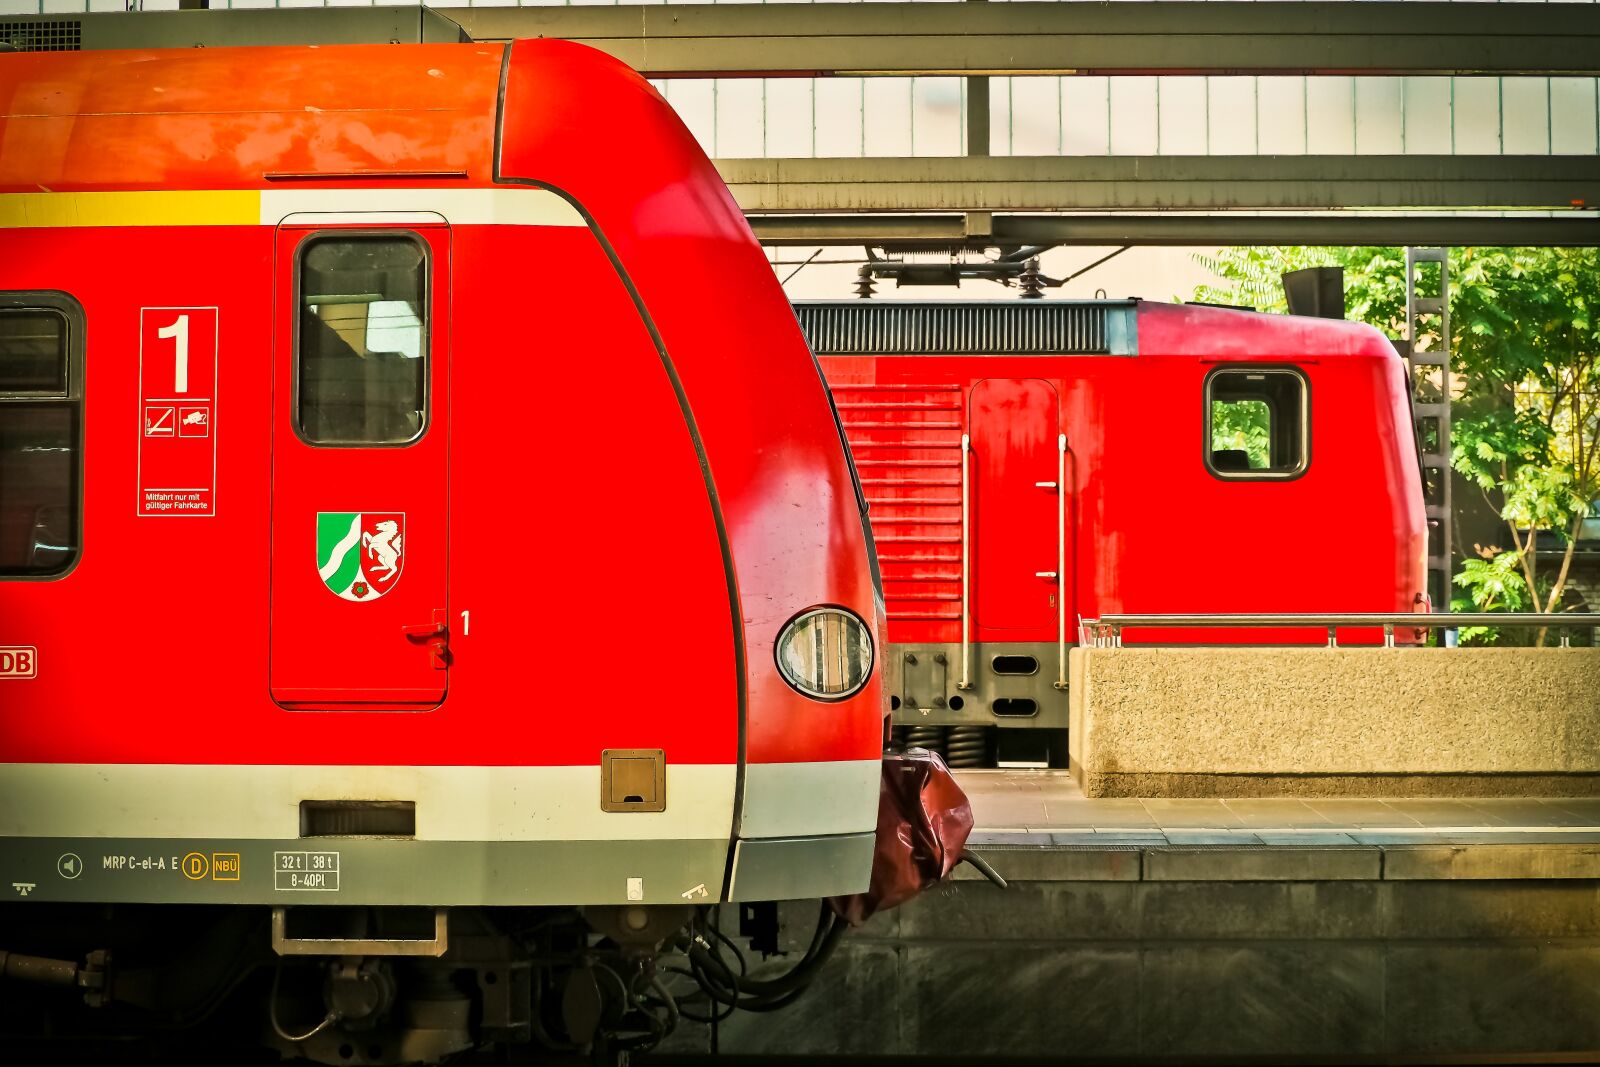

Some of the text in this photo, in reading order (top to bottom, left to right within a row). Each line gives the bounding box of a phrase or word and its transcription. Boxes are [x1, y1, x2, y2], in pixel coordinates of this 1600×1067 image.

[158, 314, 189, 393] 1
[145, 493, 174, 501] Mitfahrt
[188, 493, 200, 501] mit
[145, 501, 208, 511] gültiger Fahrkarte
[460, 610, 470, 636] 1
[0, 652, 31, 673] DB
[103, 855, 178, 870] MRP C-el-A E
[191, 857, 202, 875] D
[215, 858, 237, 872] NBÜ
[282, 855, 301, 869] 32 t
[313, 855, 332, 869] 38 t
